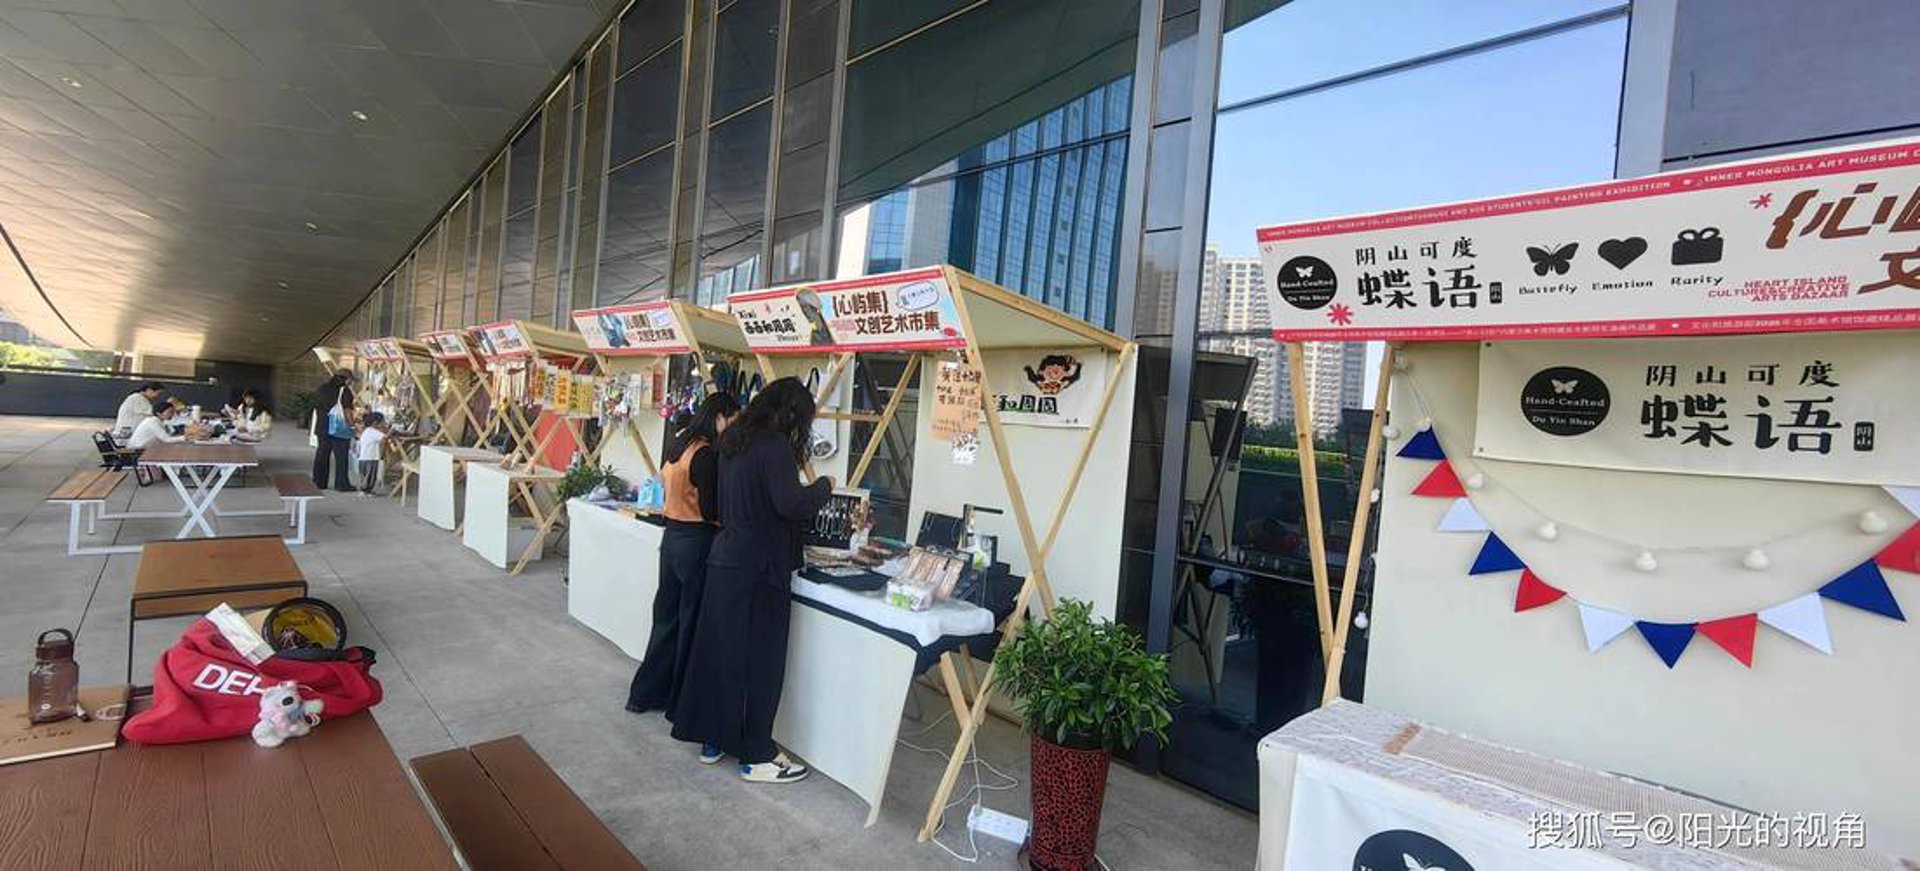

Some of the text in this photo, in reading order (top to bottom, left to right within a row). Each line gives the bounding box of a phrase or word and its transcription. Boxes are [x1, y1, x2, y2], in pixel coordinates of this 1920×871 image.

[1704, 172, 1743, 183] INNER
[1746, 164, 1814, 178] MONGOLIA
[1818, 159, 1844, 169] ART
[1849, 150, 1909, 164] MUSEUM
[1355, 236, 1478, 266] 阴山可度
[1357, 264, 1482, 310] 蝶语
[1592, 280, 1654, 291] Emotion
[1670, 275, 1724, 287] Rarity
[1744, 275, 1848, 289] HEART ISLAND
[855, 310, 940, 335] 文创艺术市集
[1646, 360, 1841, 388] 阴山可度
[1640, 393, 1842, 455] 蝶语
